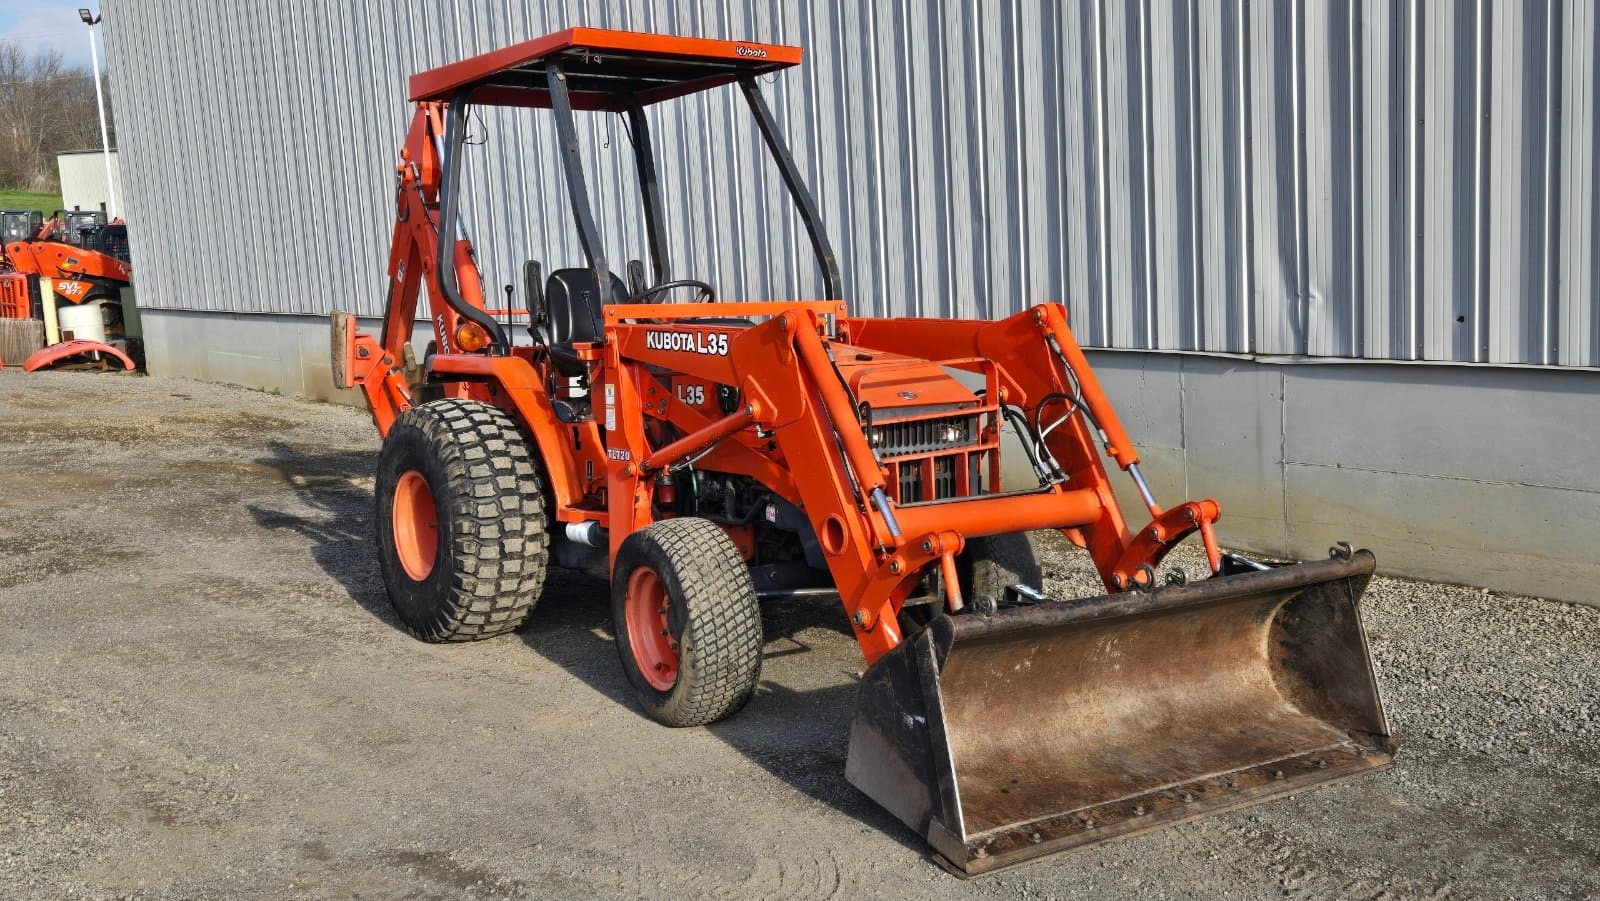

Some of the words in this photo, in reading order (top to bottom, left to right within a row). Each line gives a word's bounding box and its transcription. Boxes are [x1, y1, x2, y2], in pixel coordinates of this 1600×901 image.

[736, 46, 767, 58] Kubota
[646, 331, 695, 352] KUBOTA
[697, 332, 728, 356] L35
[677, 384, 705, 405] L35
[607, 449, 630, 461] TL720
